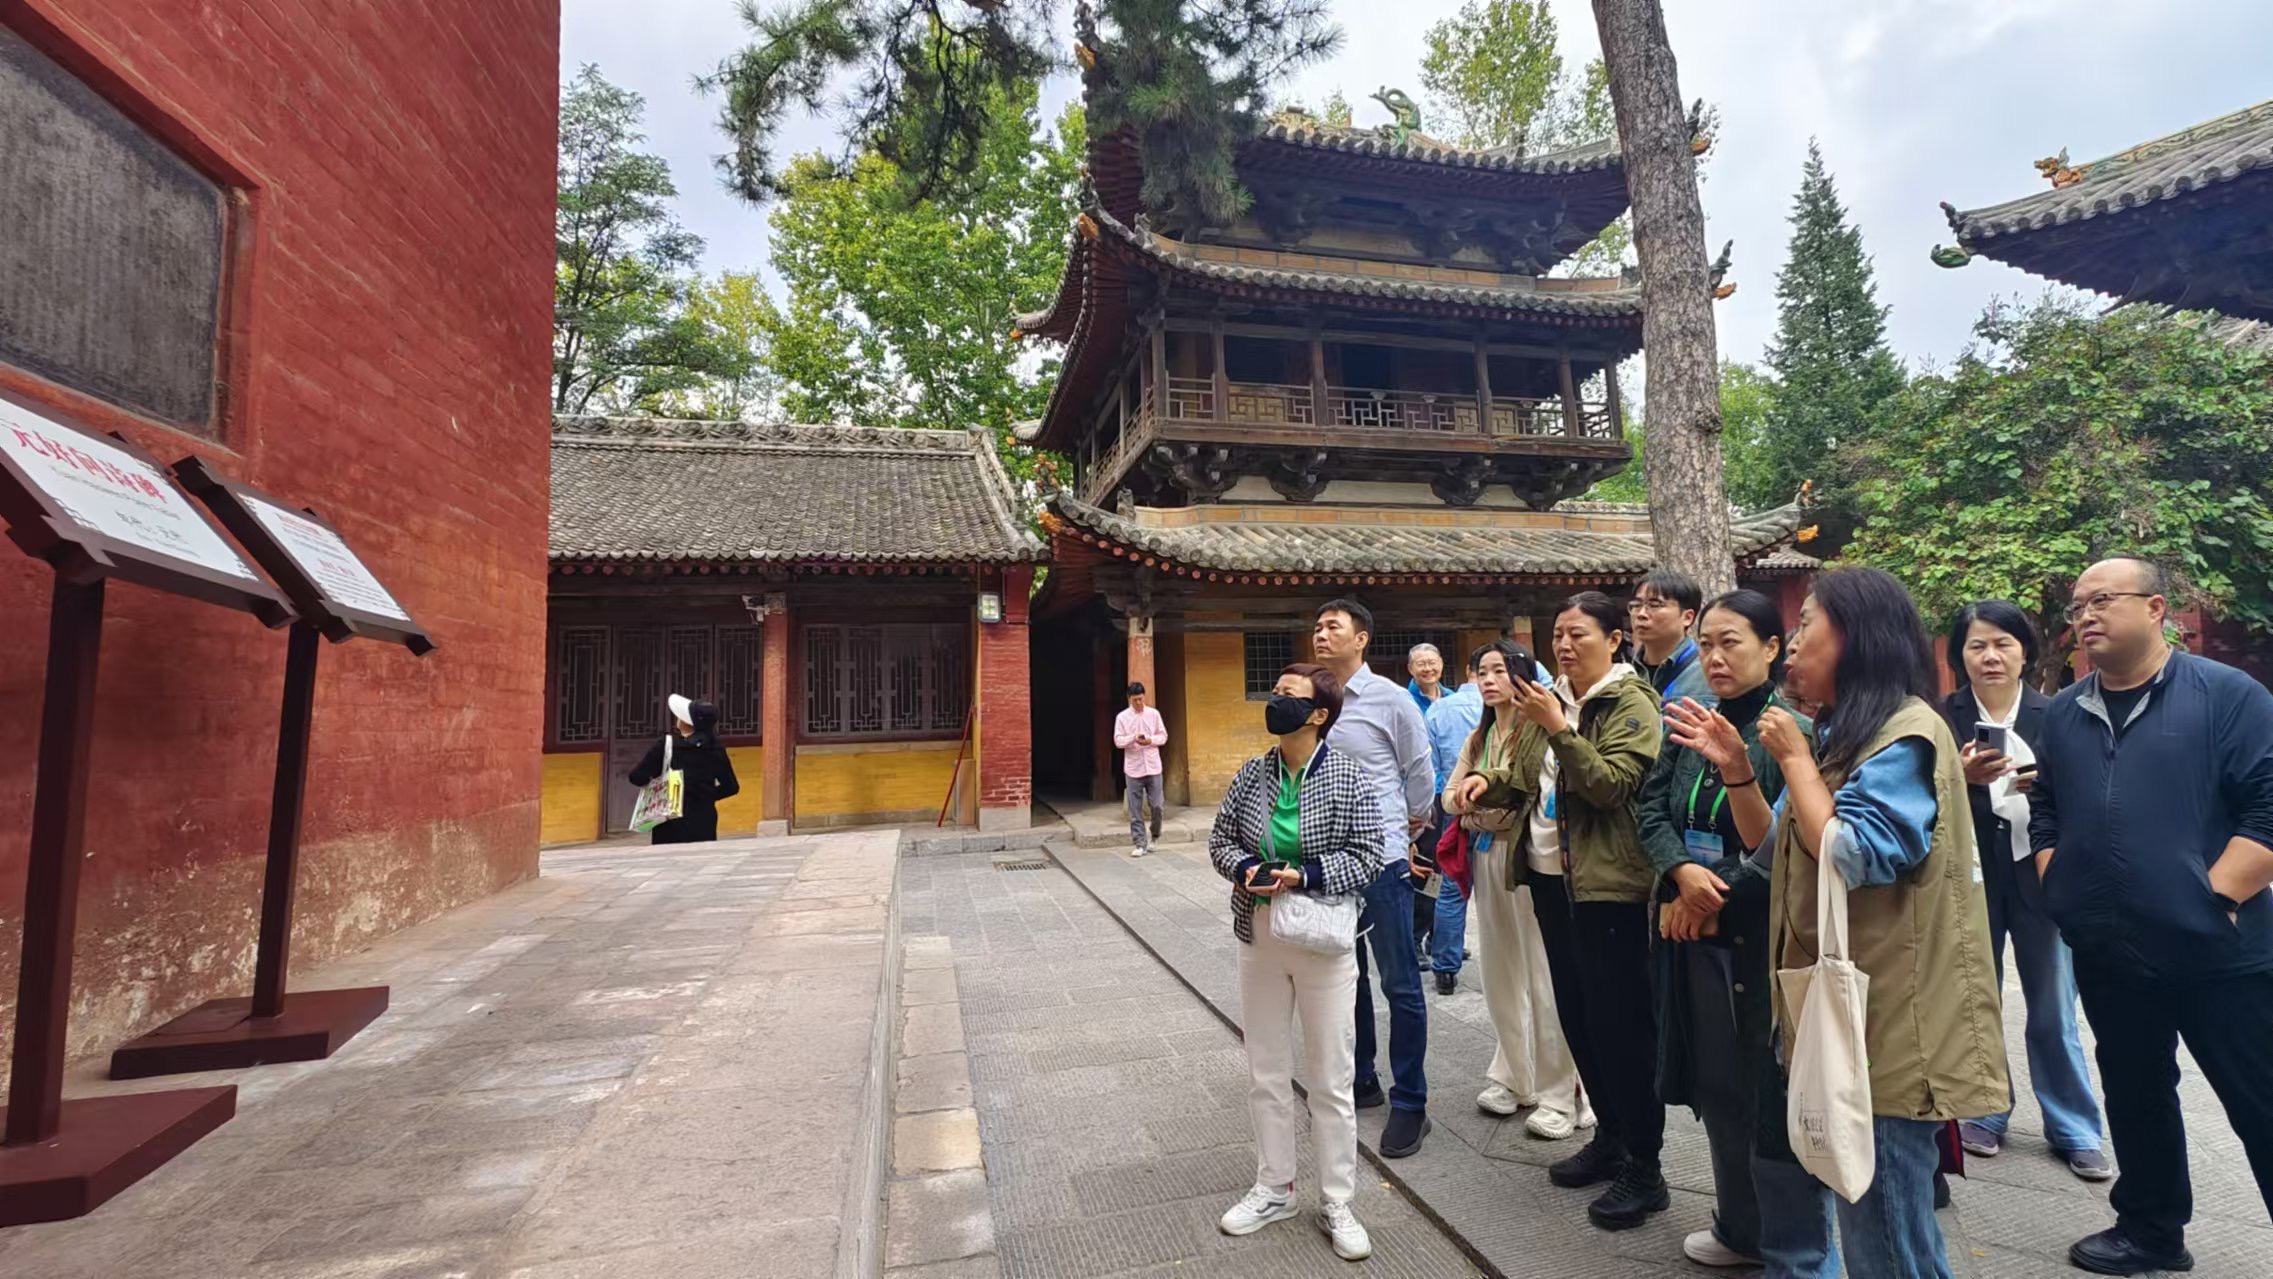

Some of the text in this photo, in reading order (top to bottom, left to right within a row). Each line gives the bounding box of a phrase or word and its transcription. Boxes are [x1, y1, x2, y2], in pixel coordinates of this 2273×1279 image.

[0, 417, 168, 504] 元好问诗碑
